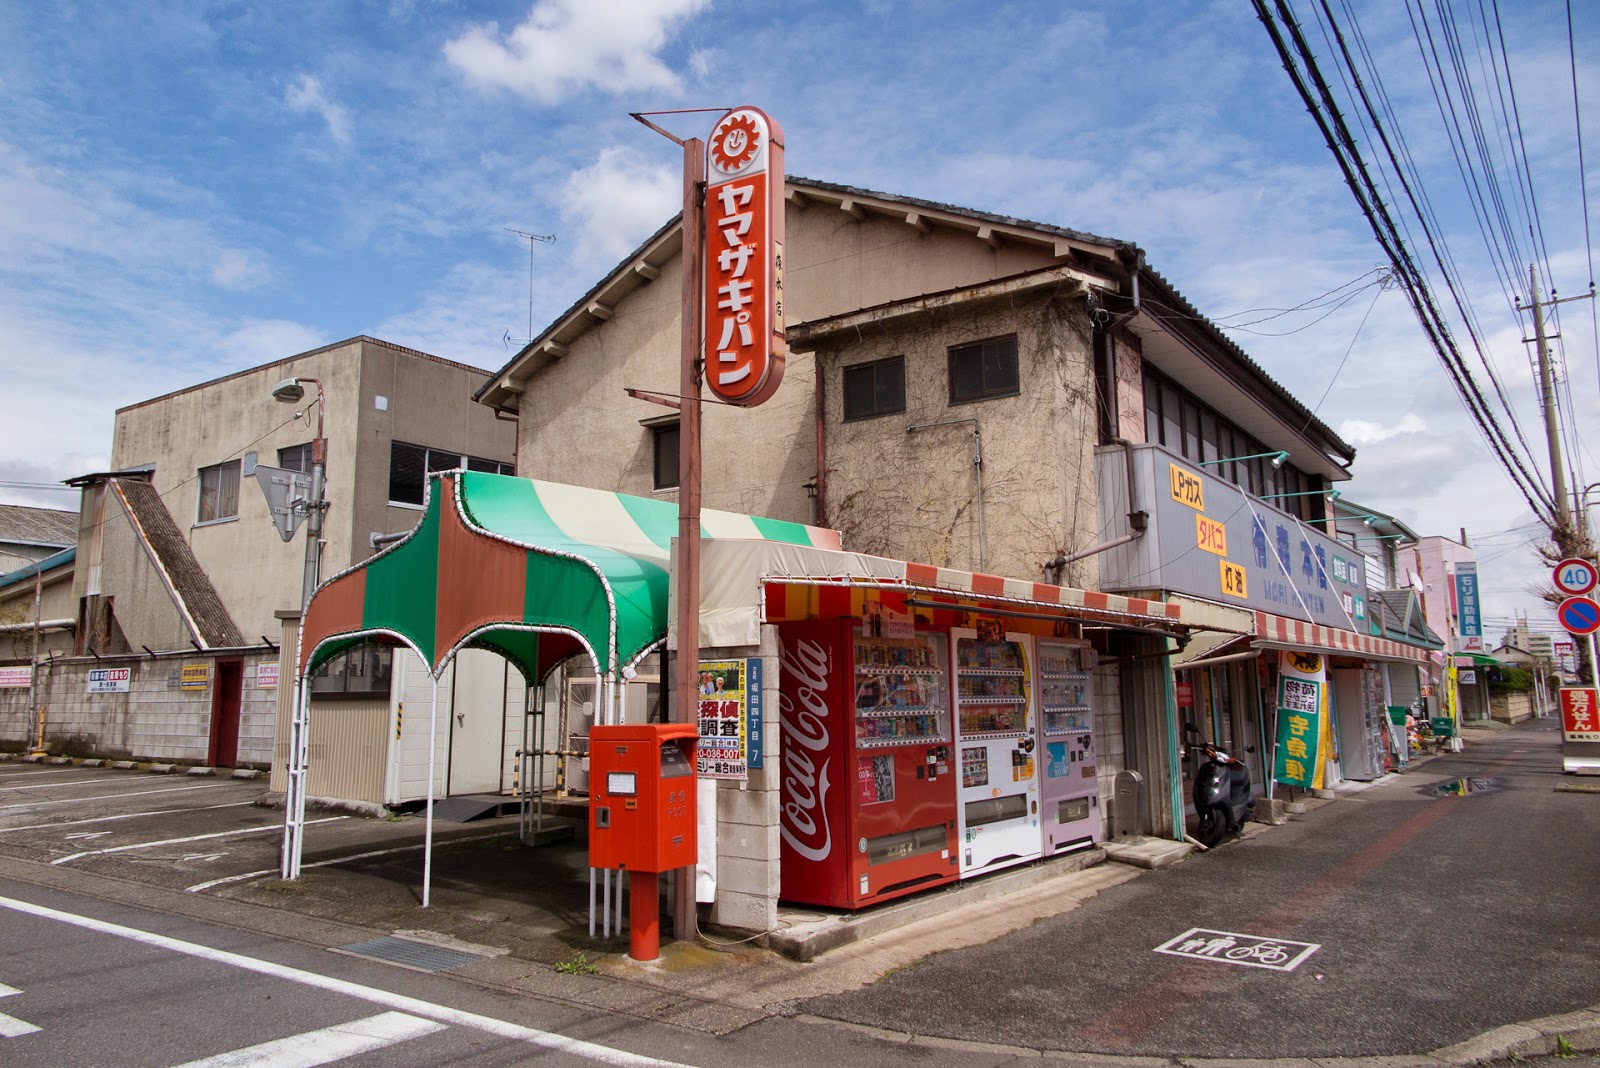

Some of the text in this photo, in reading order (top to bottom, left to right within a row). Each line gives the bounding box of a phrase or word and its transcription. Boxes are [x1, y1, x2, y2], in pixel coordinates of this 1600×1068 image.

[718, 184, 756, 385] ヤマザキパン
[1170, 467, 1203, 506] LPガス
[1199, 519, 1224, 551] タバコ
[1224, 563, 1243, 594] 灯油
[1264, 579, 1288, 605] MORI
[1563, 569, 1588, 585] 40
[1461, 576, 1477, 635] モリ運動具店
[698, 701, 739, 719] 探偵
[751, 682, 759, 741] 坂田四丁目
[1569, 690, 1592, 731] 処方せん
[698, 719, 739, 737] 調査
[697, 749, 739, 759] 0-036-007
[752, 749, 759, 762] 7
[778, 637, 831, 863] Coca-Cola
[668, 805, 687, 818] POST
